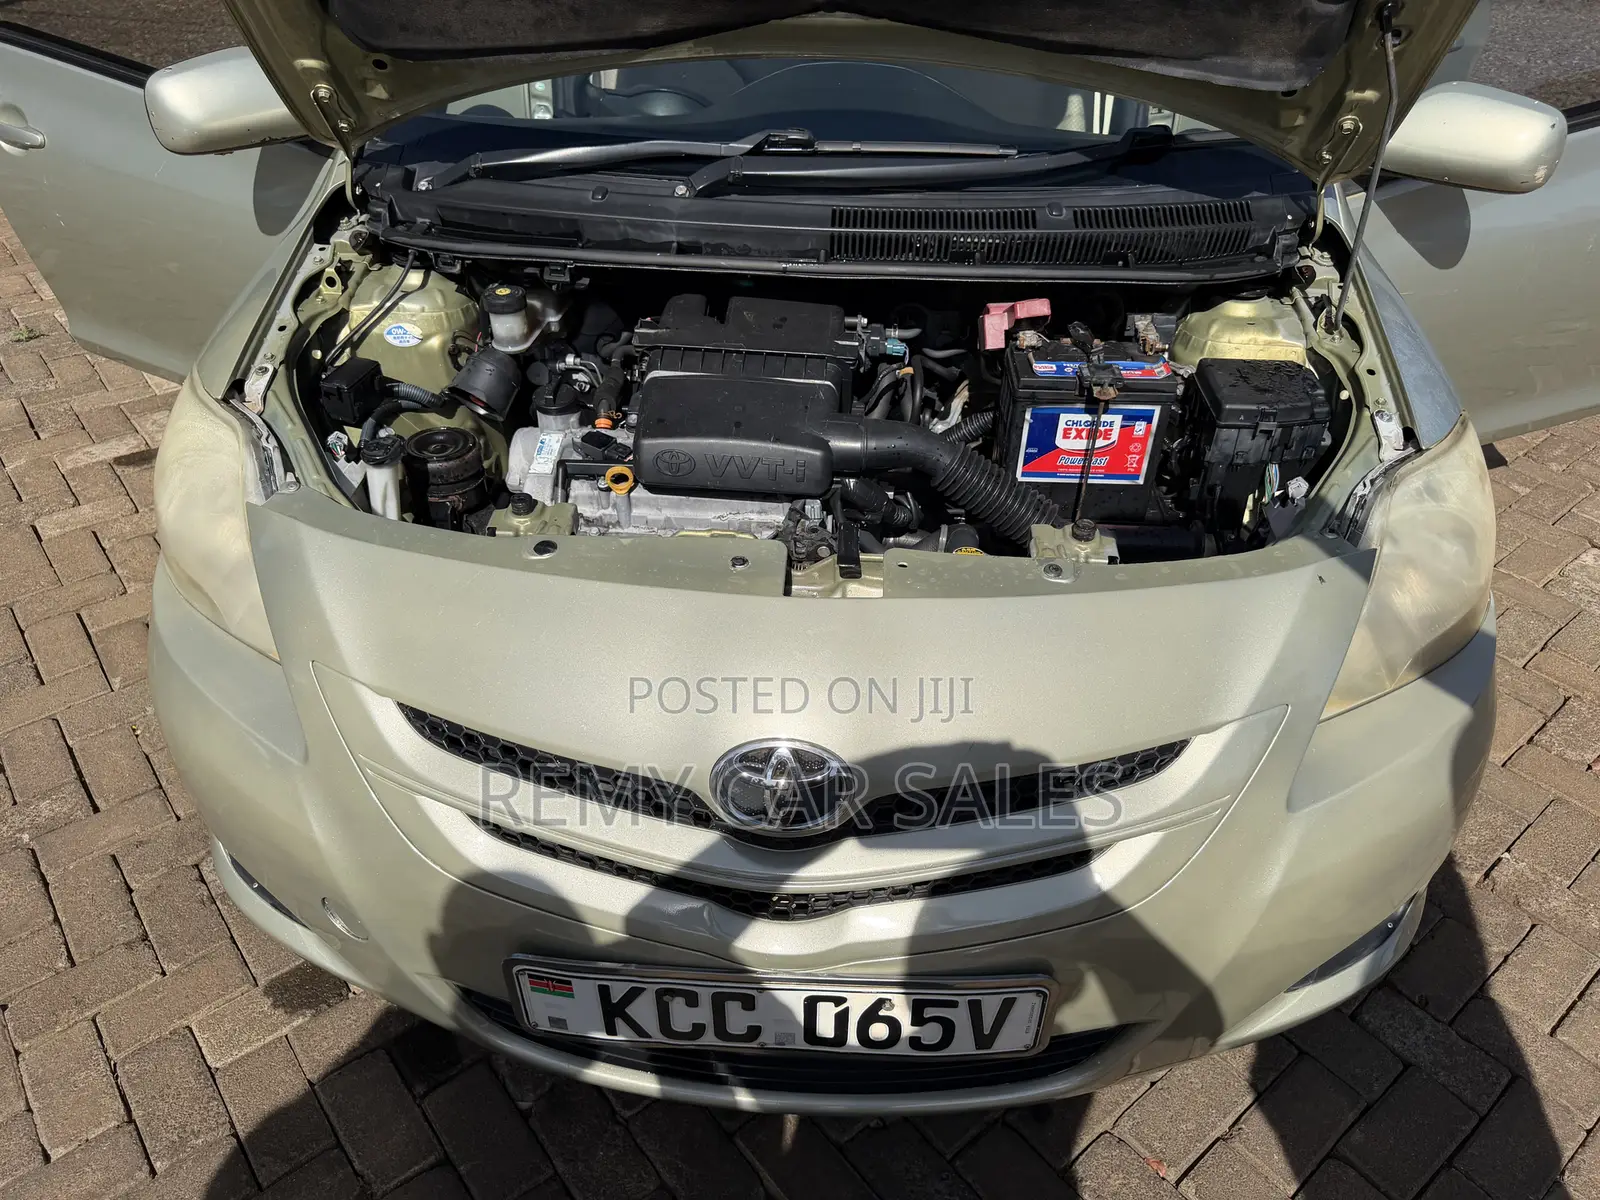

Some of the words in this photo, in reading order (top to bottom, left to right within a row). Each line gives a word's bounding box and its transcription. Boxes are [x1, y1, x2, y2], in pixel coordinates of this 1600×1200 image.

[1062, 427, 1114, 441] EXIDE
[704, 453, 806, 483] VVT-i
[1058, 456, 1108, 466] Powerast
[597, 983, 762, 1043] KCC
[803, 994, 1018, 1053] 065V
